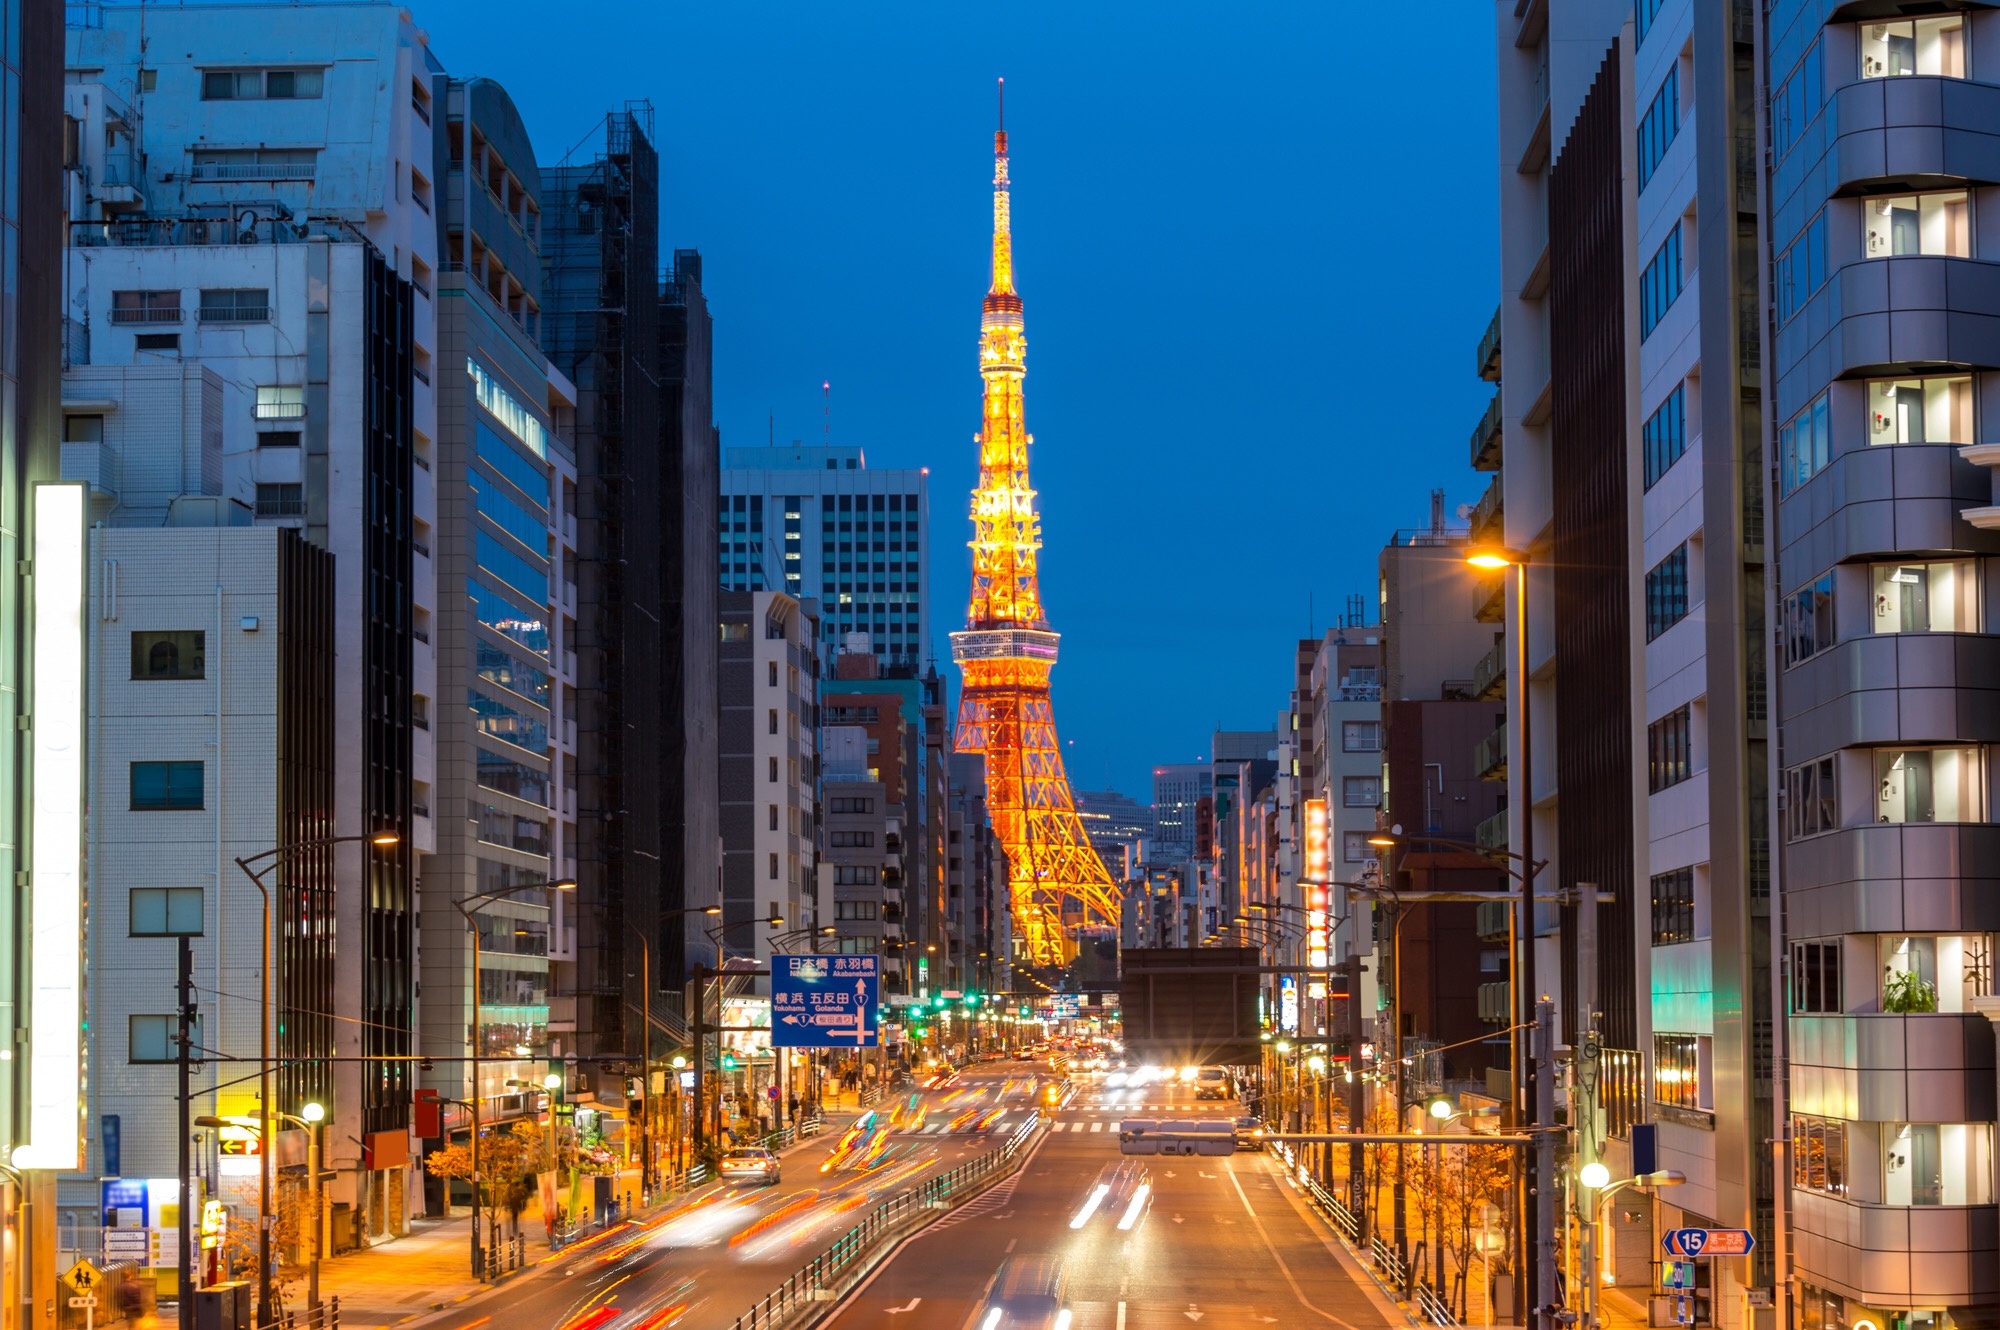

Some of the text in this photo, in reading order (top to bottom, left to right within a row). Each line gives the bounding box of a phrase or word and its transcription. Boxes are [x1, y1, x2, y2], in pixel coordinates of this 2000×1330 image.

[790, 958, 874, 969] 日本橋 赤羽橋
[775, 993, 849, 1004] 横浜 五反田
[858, 996, 863, 1004] 1
[801, 1015, 806, 1023] 1
[245, 1140, 258, 1154] P
[1682, 1233, 1702, 1250] 15
[1709, 1233, 1743, 1244] 第一京浜
